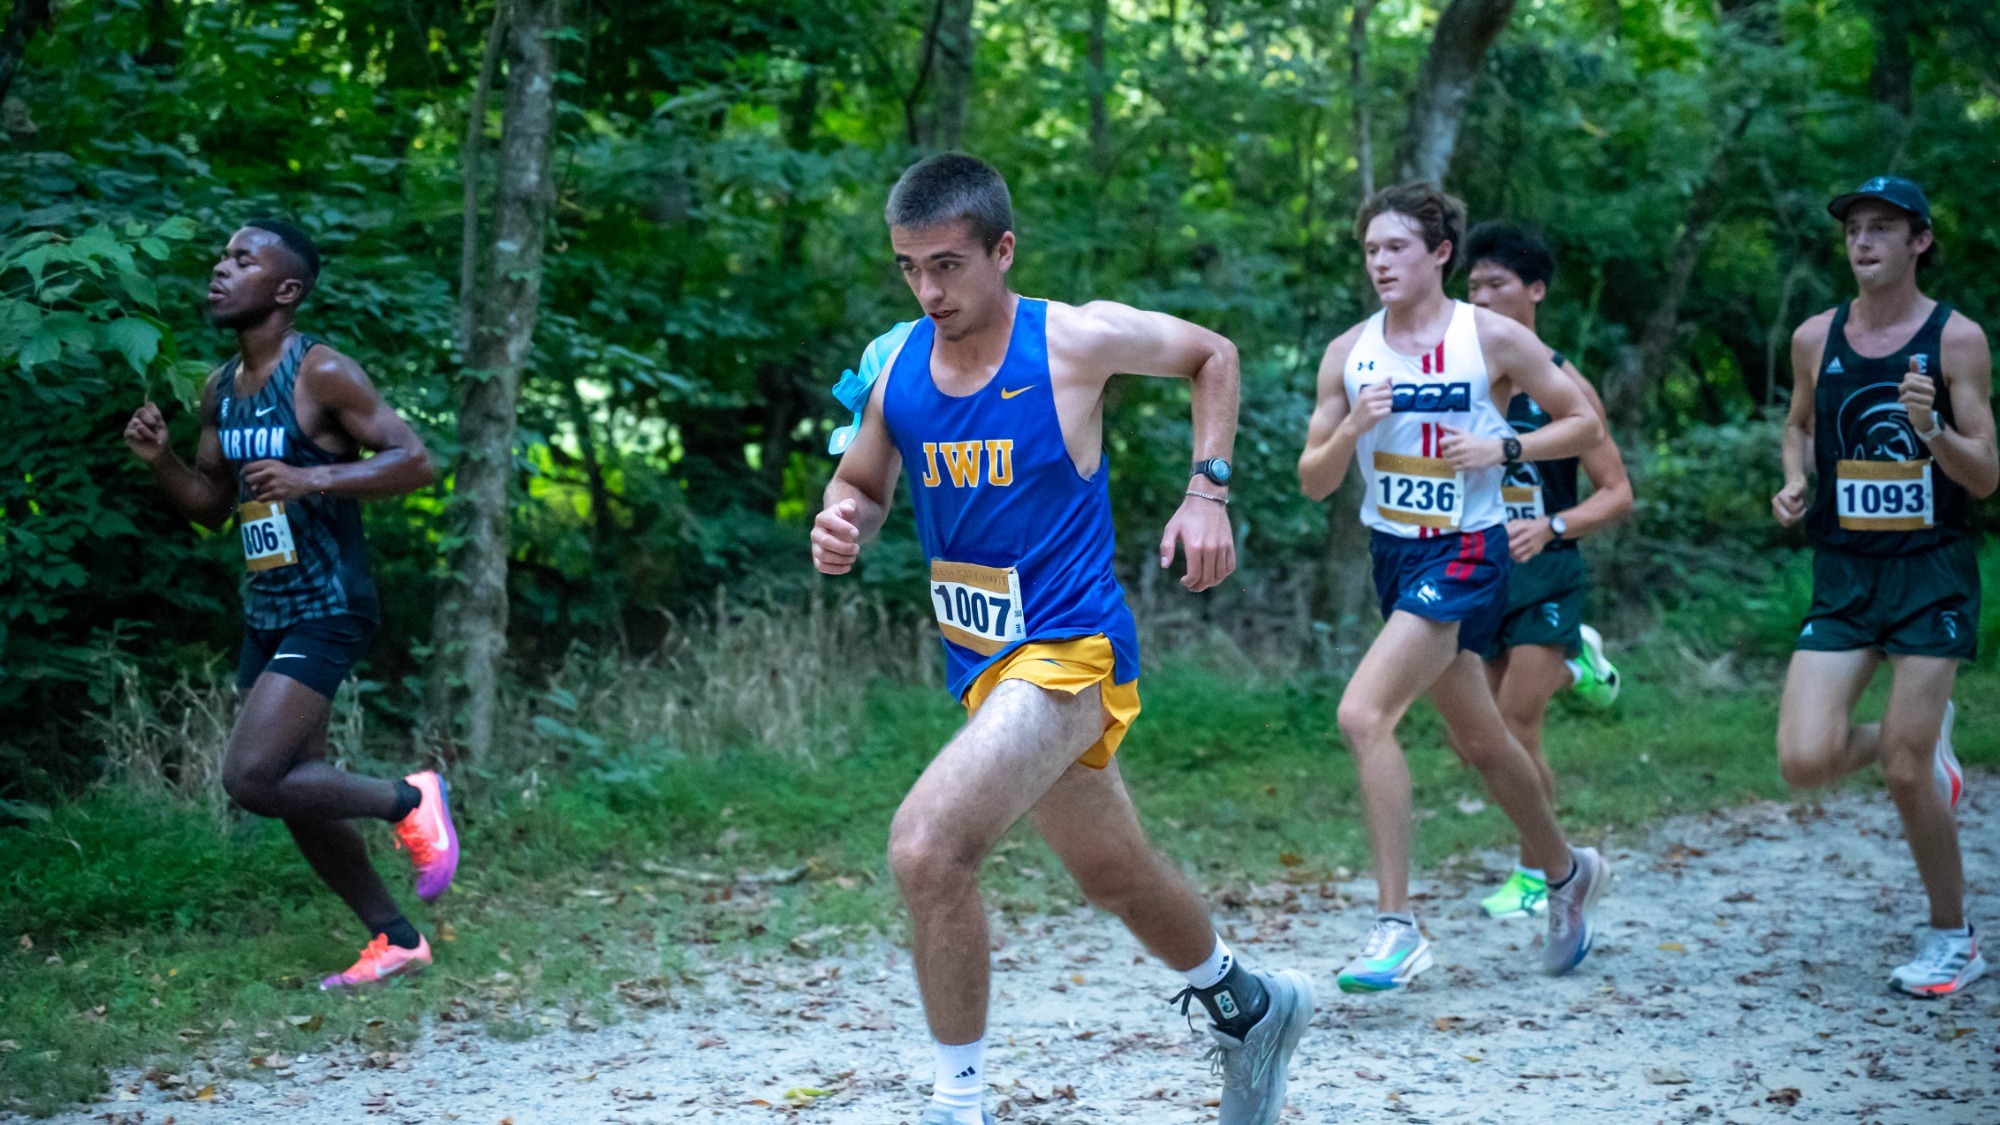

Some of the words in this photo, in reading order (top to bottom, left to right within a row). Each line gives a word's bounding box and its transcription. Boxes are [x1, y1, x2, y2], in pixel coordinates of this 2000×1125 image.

[922, 439, 1014, 488] JWU
[1379, 475, 1456, 513] 1236
[1842, 483, 1925, 514] 1093
[934, 584, 1011, 637] 1007
